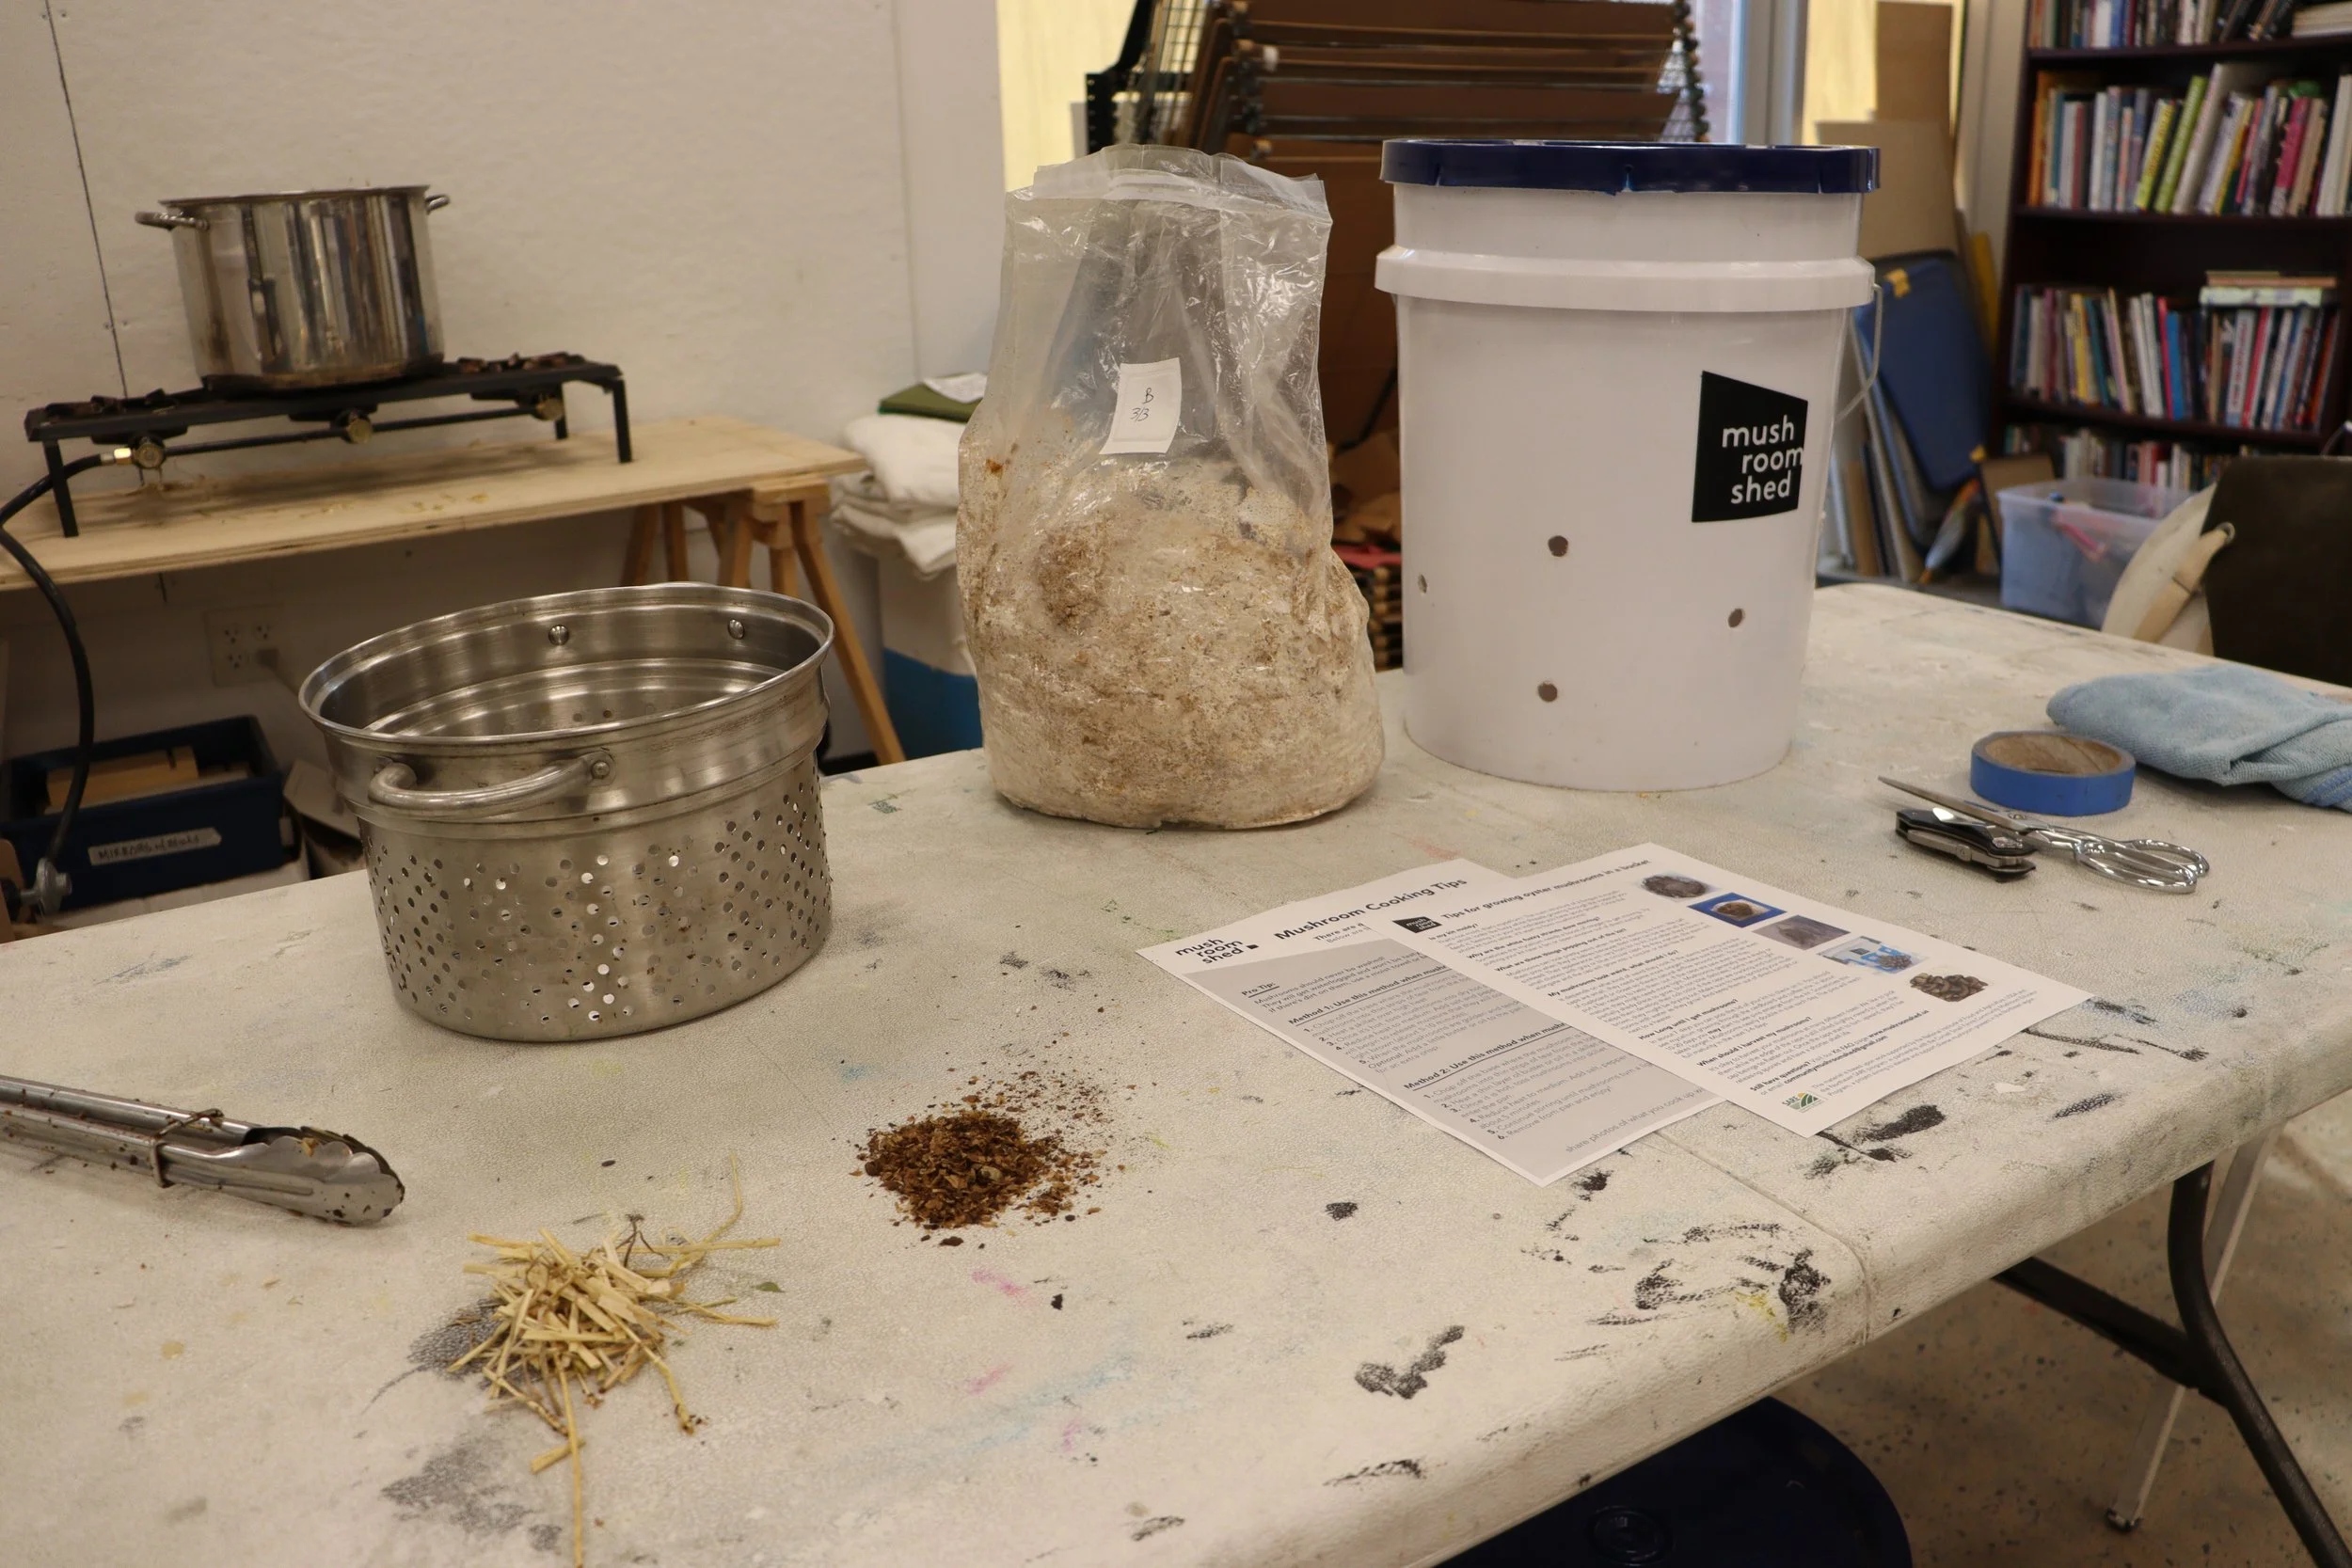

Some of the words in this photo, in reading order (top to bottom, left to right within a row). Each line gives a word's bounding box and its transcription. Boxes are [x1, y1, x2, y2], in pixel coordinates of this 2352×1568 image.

[1142, 387, 1153, 404] B
[1722, 415, 1795, 448] mush
[1742, 447, 1803, 474] room
[1731, 470, 1792, 504] shed
[1482, 895, 1523, 909] growing
[1523, 887, 1551, 896] oyster
[1553, 873, 1604, 889] mushrooms
[1618, 860, 1650, 870] bucket
[1274, 910, 1365, 939] Mushroom
[1365, 888, 1435, 910] Cooking
[1430, 879, 1467, 890] Tips
[1175, 939, 1223, 956] mush
[1196, 941, 1243, 957] room
[1313, 930, 1340, 941] There
[1202, 946, 1244, 963] shed
[1288, 1007, 1323, 1024] Method
[1332, 998, 1351, 1006] Use
[1368, 980, 1400, 994] method
[1400, 973, 1422, 982] when
[1696, 1056, 1718, 1067] When
[1717, 1047, 1739, 1058] should
[1740, 1036, 1766, 1047] harvest
[1775, 1016, 1812, 1033] mushrooms?
[1403, 1072, 1439, 1089] Method
[1449, 1060, 1468, 1069] Use
[1467, 1053, 1486, 1061] this
[1486, 1039, 1518, 1054] method
[1518, 1031, 1541, 1041] when
[1565, 1140, 1590, 1153] share
[1589, 1125, 1620, 1142] photos
[1618, 1118, 1629, 1127] of
[1628, 1111, 1649, 1122] what
[1647, 1105, 1664, 1115] you
[1663, 1096, 1684, 1107] cook
